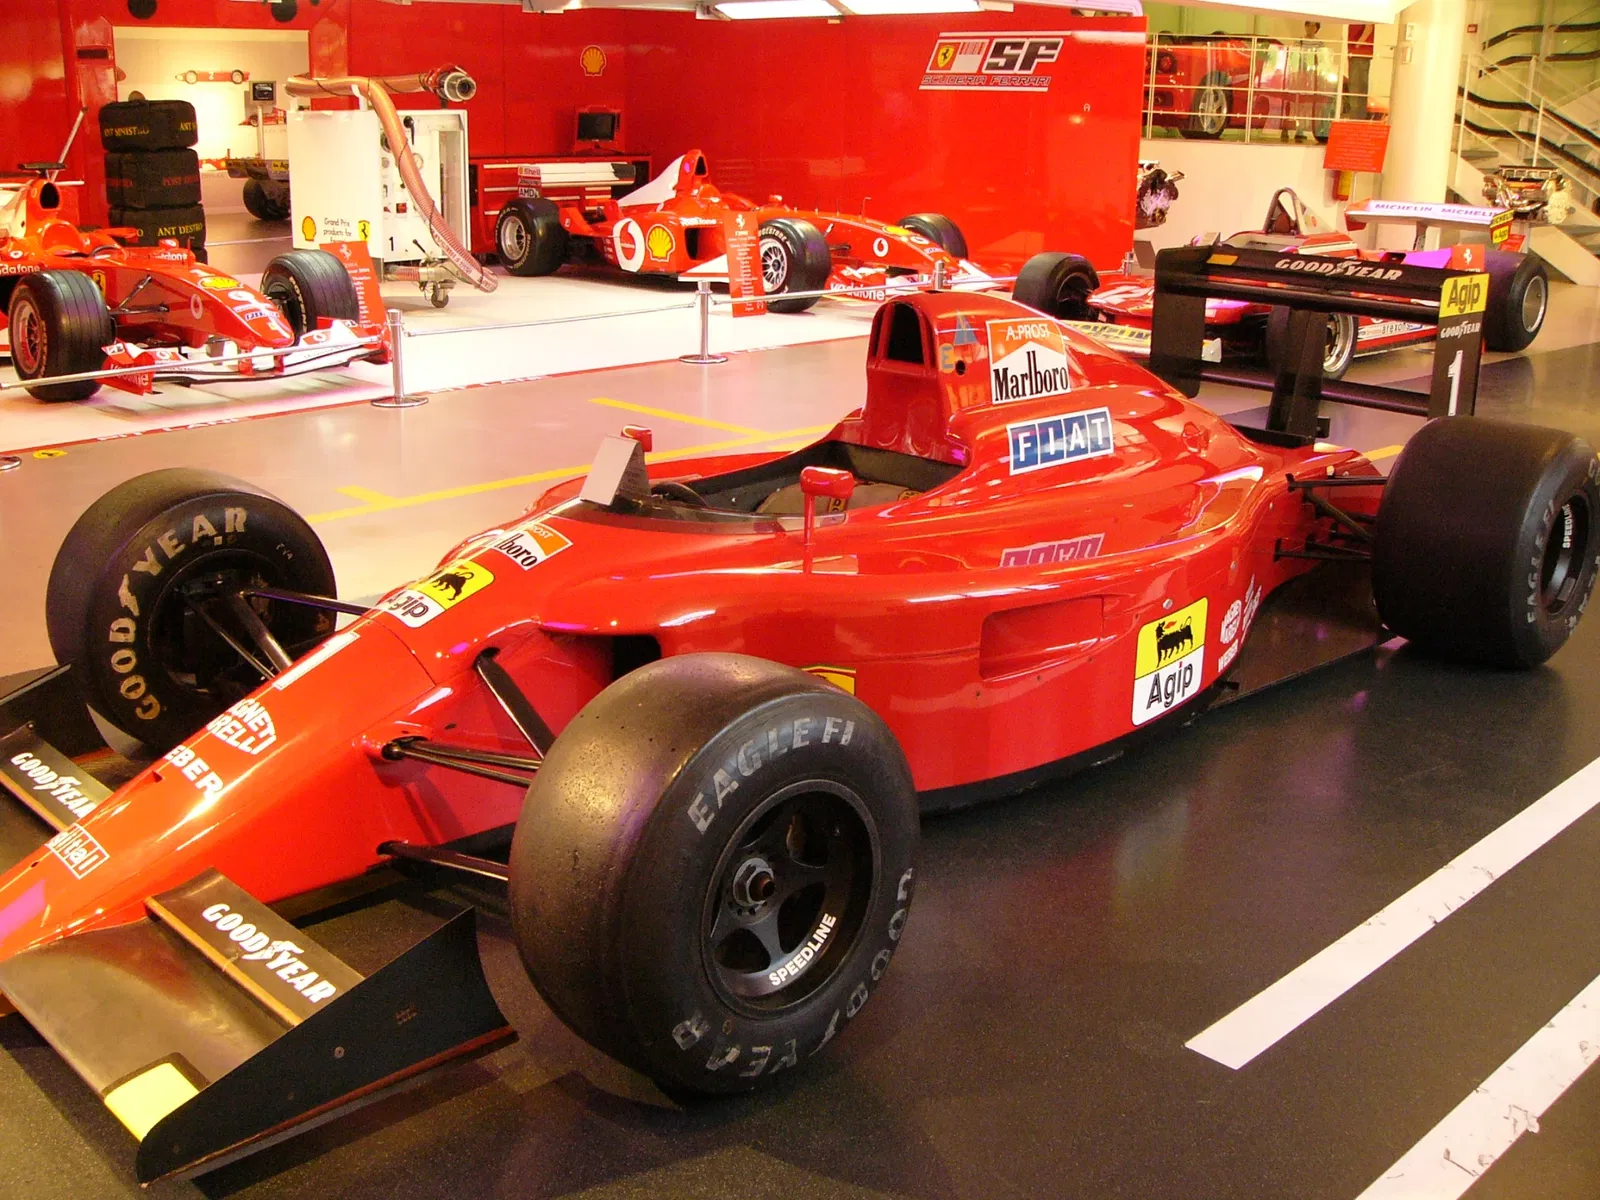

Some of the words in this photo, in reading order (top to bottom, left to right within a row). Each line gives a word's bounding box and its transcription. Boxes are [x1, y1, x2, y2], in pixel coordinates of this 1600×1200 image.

[982, 38, 1064, 74] SF
[922, 75, 986, 85] SCUDERIA
[990, 76, 1051, 86] FERRARI
[324, 217, 339, 226] Grand
[1375, 203, 1432, 211] MICHELIN
[157, 226, 177, 237] ANT
[179, 223, 203, 235] DESTRO
[323, 228, 343, 236] products
[389, 236, 395, 251] 1
[1275, 259, 1403, 281] GOODYEAR
[1447, 278, 1481, 313] Agip
[1006, 323, 1051, 341] A.PROST
[1440, 320, 1481, 339] GOODYEAR
[993, 350, 1069, 401] Marlboro
[1448, 350, 1464, 417] 1
[1019, 417, 1106, 462] FIAT
[495, 532, 538, 567] lboro
[109, 506, 248, 721] GOODYEAR
[1146, 660, 1193, 709] Agip
[687, 717, 811, 836] EAGLE
[202, 903, 336, 1003] GOODYEAR
[769, 913, 837, 986] SPEEDLINE
